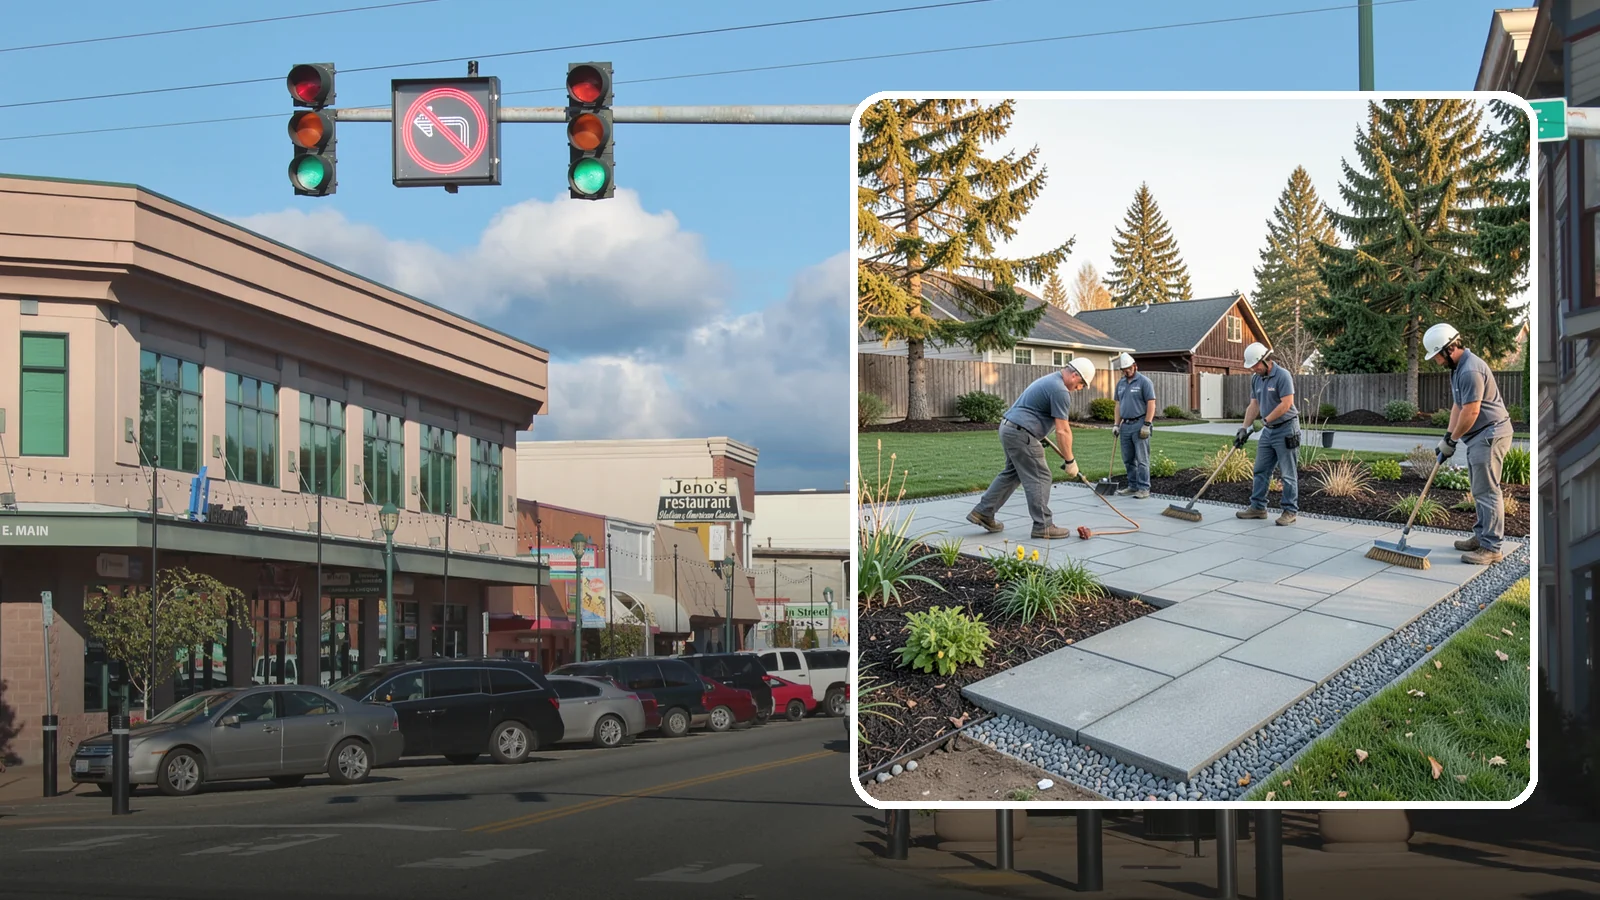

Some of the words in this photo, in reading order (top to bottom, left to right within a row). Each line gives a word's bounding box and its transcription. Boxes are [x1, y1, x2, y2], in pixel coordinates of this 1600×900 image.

[669, 480, 728, 494] Jeno's
[665, 496, 731, 509] restaurant
[658, 509, 681, 519] Italian
[685, 509, 715, 519] American
[714, 509, 738, 519] Cuisine
[2, 525, 13, 536] E.
[15, 525, 49, 536] MAIN
[797, 607, 829, 617] Street
[790, 619, 824, 627] lass
